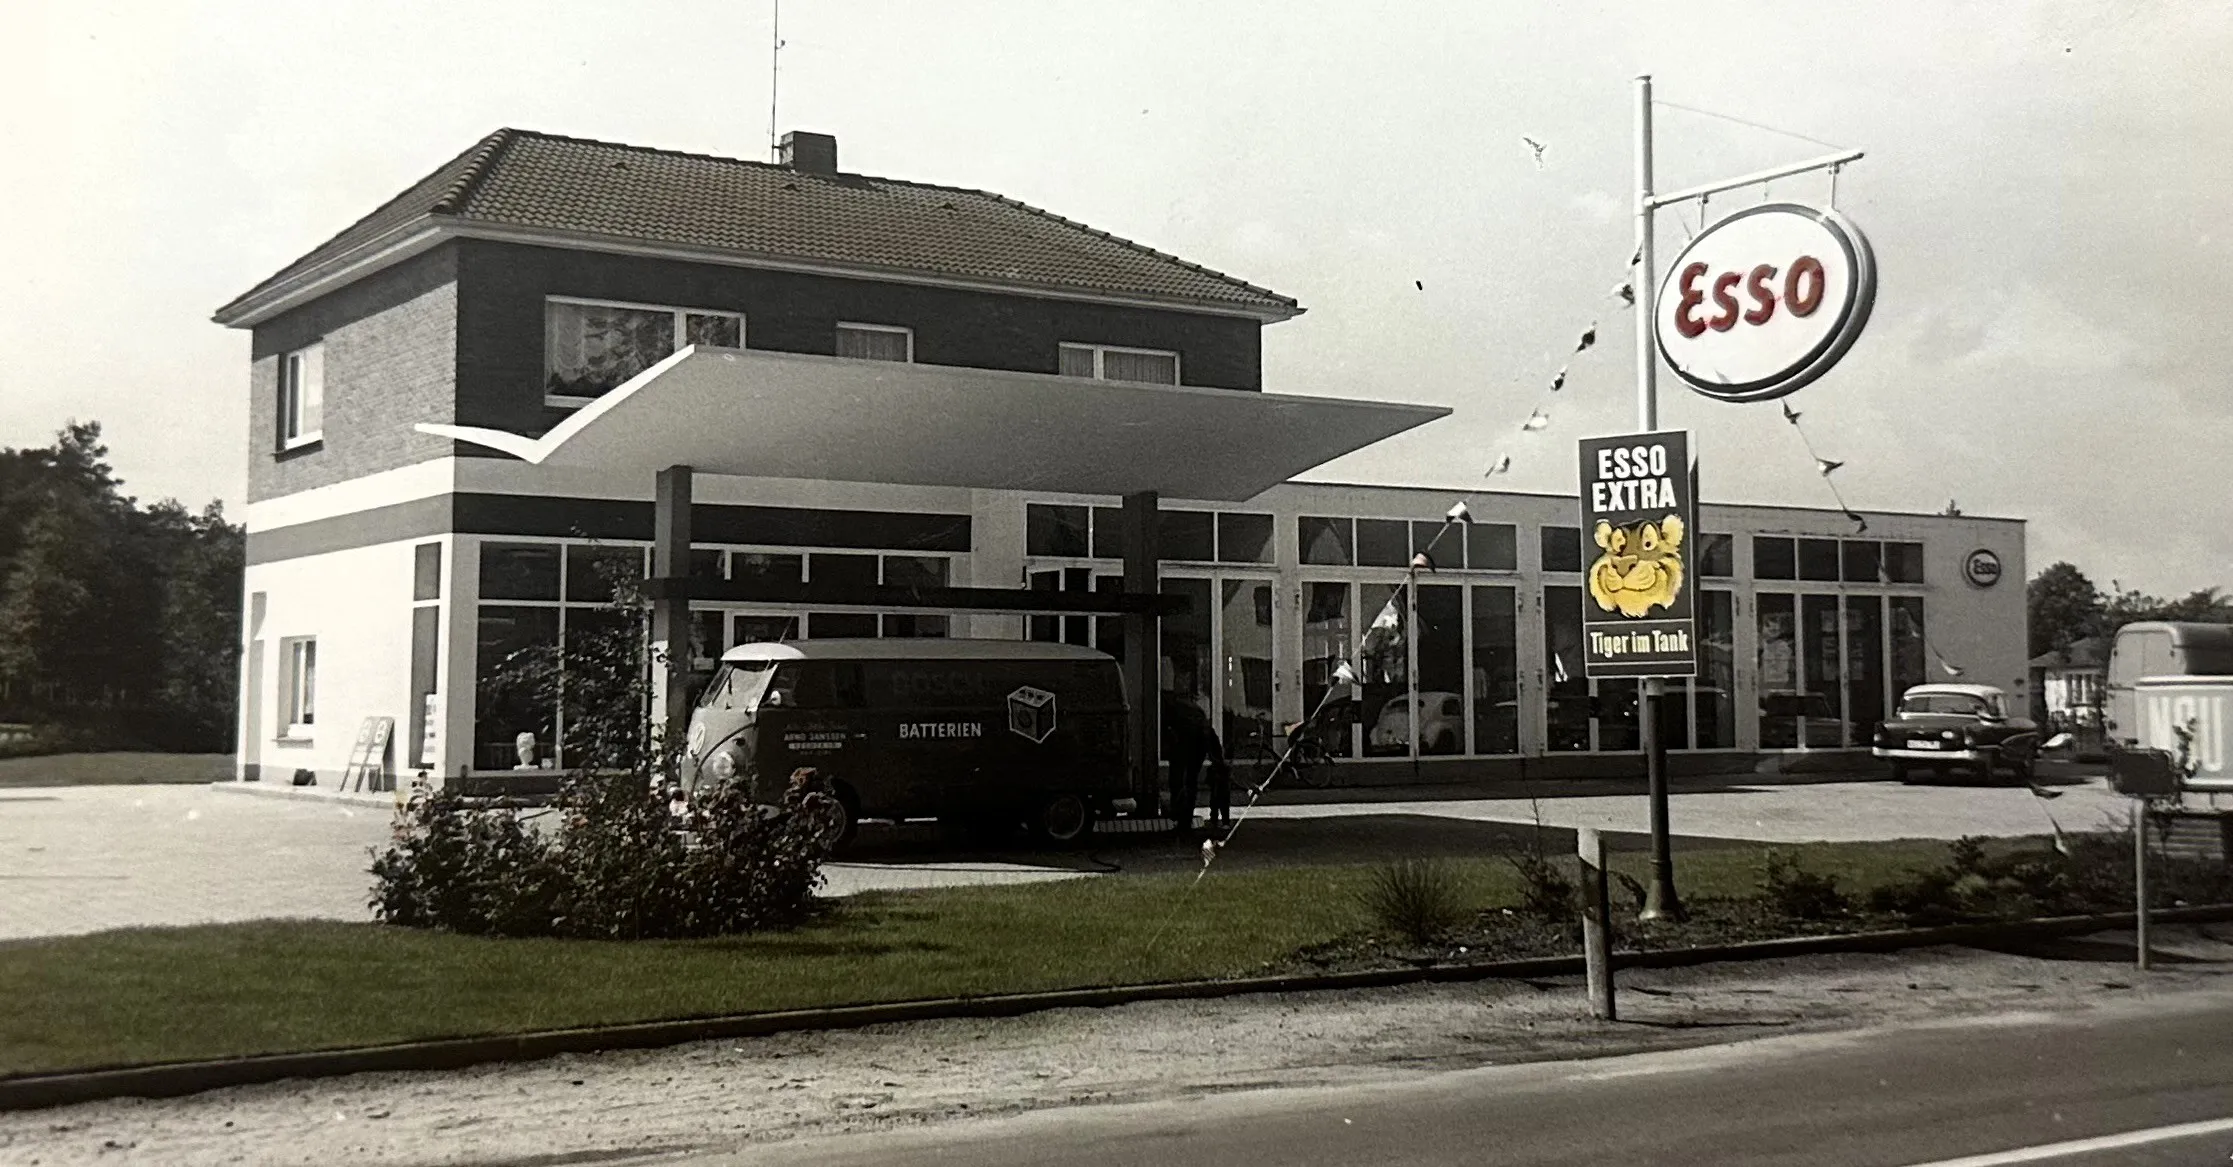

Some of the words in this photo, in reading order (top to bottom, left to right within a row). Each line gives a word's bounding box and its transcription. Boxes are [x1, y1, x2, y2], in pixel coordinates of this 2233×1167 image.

[1598, 445, 1666, 479] ESSO
[1592, 477, 1677, 512] EXTRA
[1973, 558, 1997, 575] Esso
[1590, 632, 1629, 658] Tiger
[1632, 630, 1650, 653] im
[1652, 629, 1688, 653] Tank
[899, 722, 982, 738] BATTERIEN
